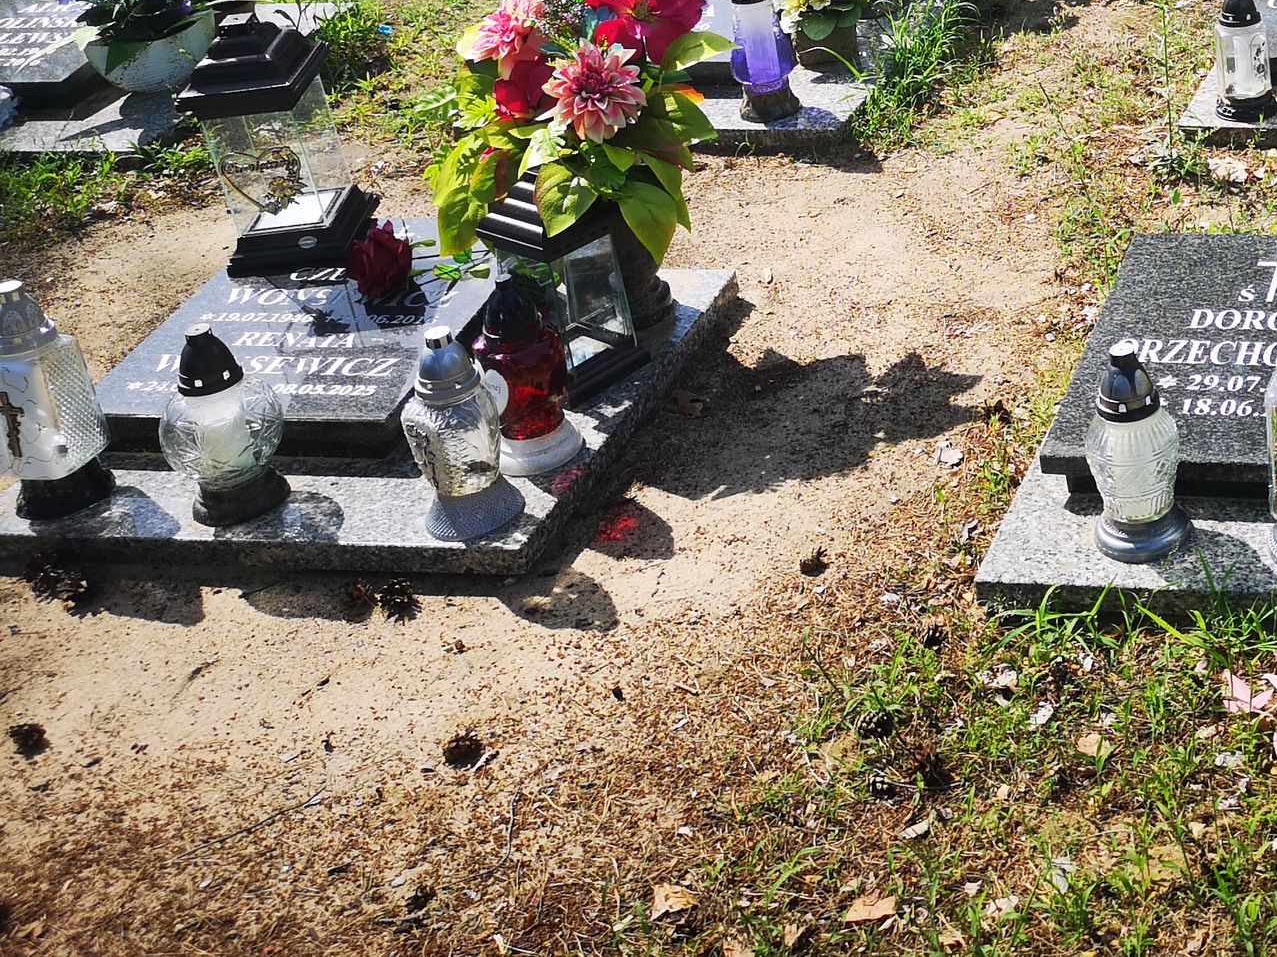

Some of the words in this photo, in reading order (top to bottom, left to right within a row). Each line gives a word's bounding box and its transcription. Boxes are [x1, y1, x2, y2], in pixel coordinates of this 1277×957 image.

[1237, 284, 1256, 302] Ś
[234, 331, 357, 348] RENATA
[155, 353, 401, 377] WSEWICZ
[272, 382, 378, 397] 08.05.2025
